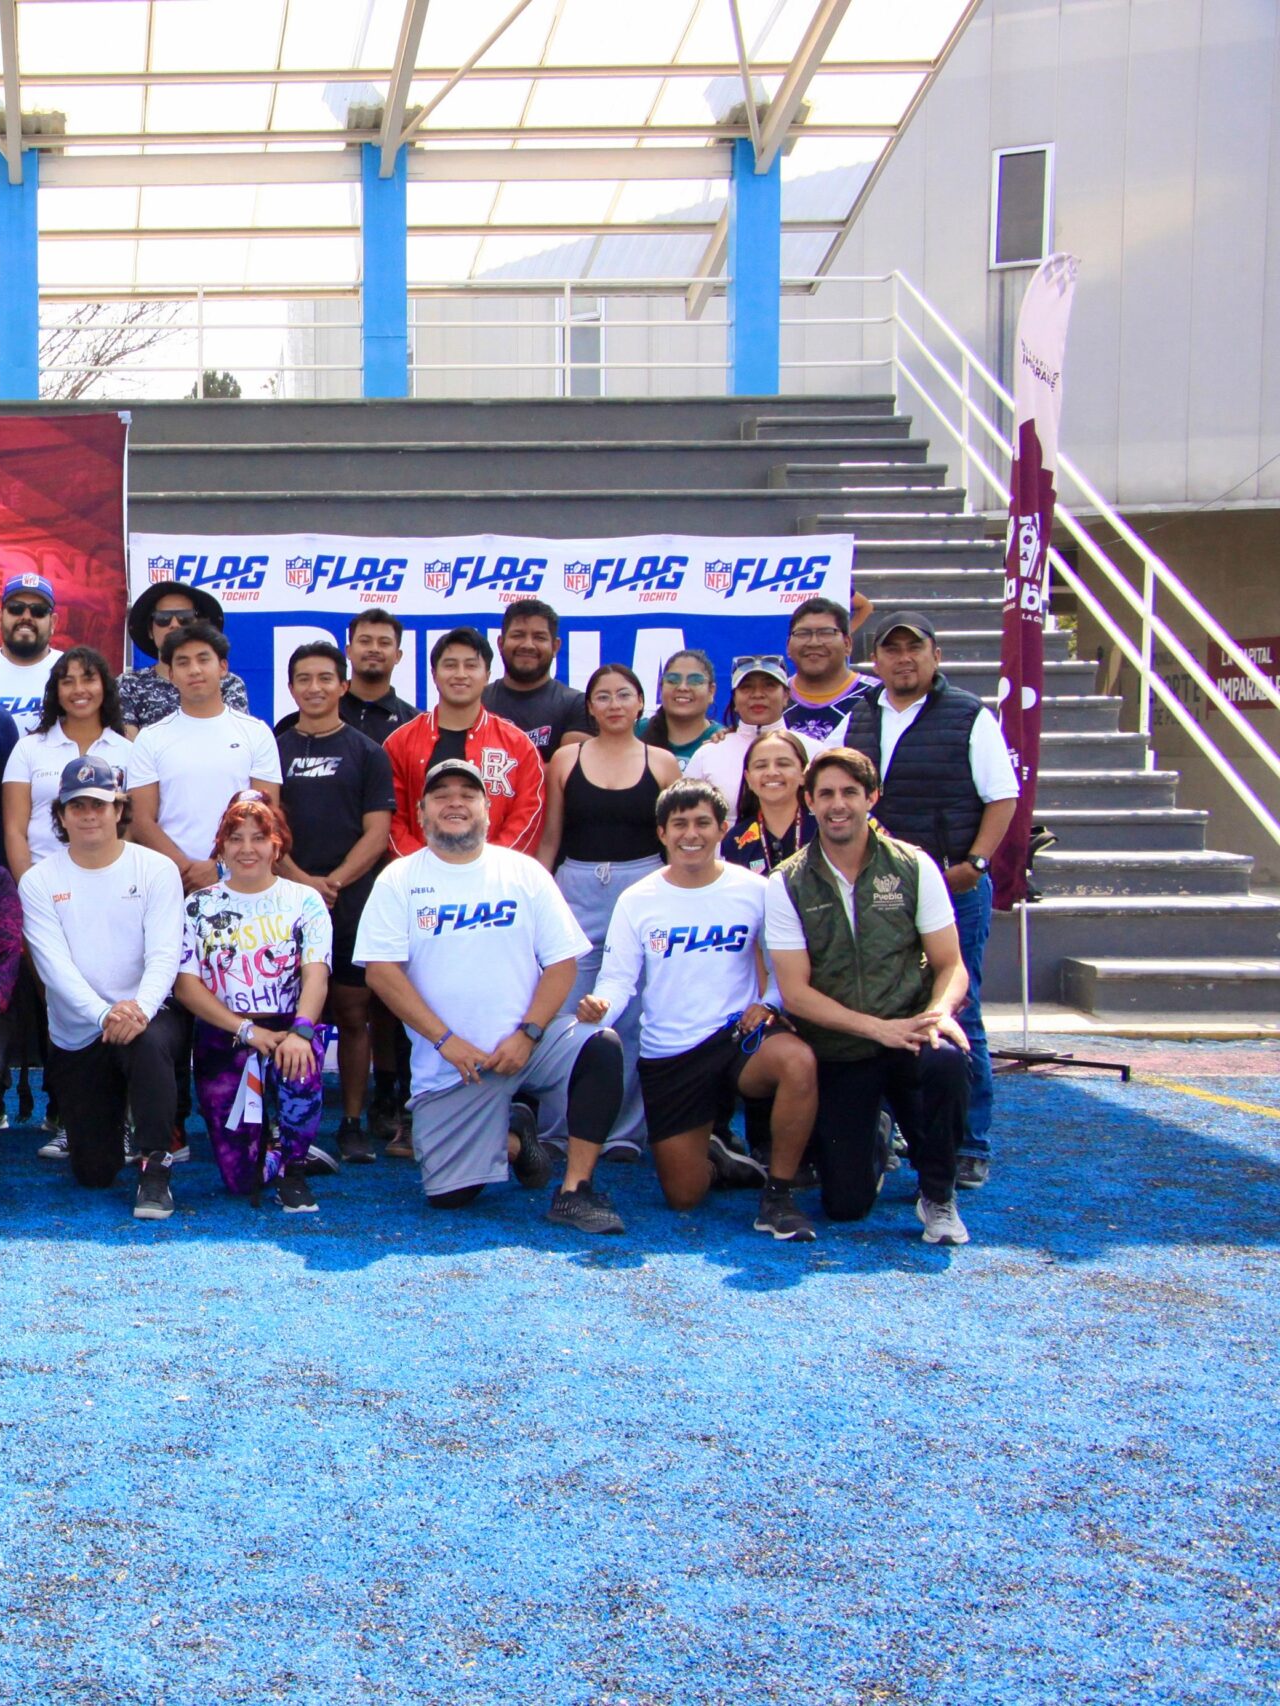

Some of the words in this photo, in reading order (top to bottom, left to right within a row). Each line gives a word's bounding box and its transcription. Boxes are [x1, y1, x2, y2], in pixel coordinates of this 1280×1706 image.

[150, 568, 173, 584] NFL
[174, 555, 269, 587] FLAG
[288, 569, 310, 585] NFL
[306, 554, 408, 595] FLAG
[427, 572, 449, 589] NFL
[444, 555, 548, 598] FLAG
[566, 574, 589, 591] NFL
[583, 555, 689, 600] FLAG
[706, 572, 730, 589] NFL
[724, 555, 831, 599] FLAG
[221, 591, 260, 601] TOCHITO
[359, 593, 398, 603] TOCHITO
[638, 592, 677, 602] TOCHITO
[287, 757, 343, 777] NIKE
[873, 893, 903, 901] Puebla
[419, 916, 436, 928] NFL
[433, 900, 517, 936] FLAG
[651, 939, 666, 949] NFL
[663, 925, 749, 959] FLAG
